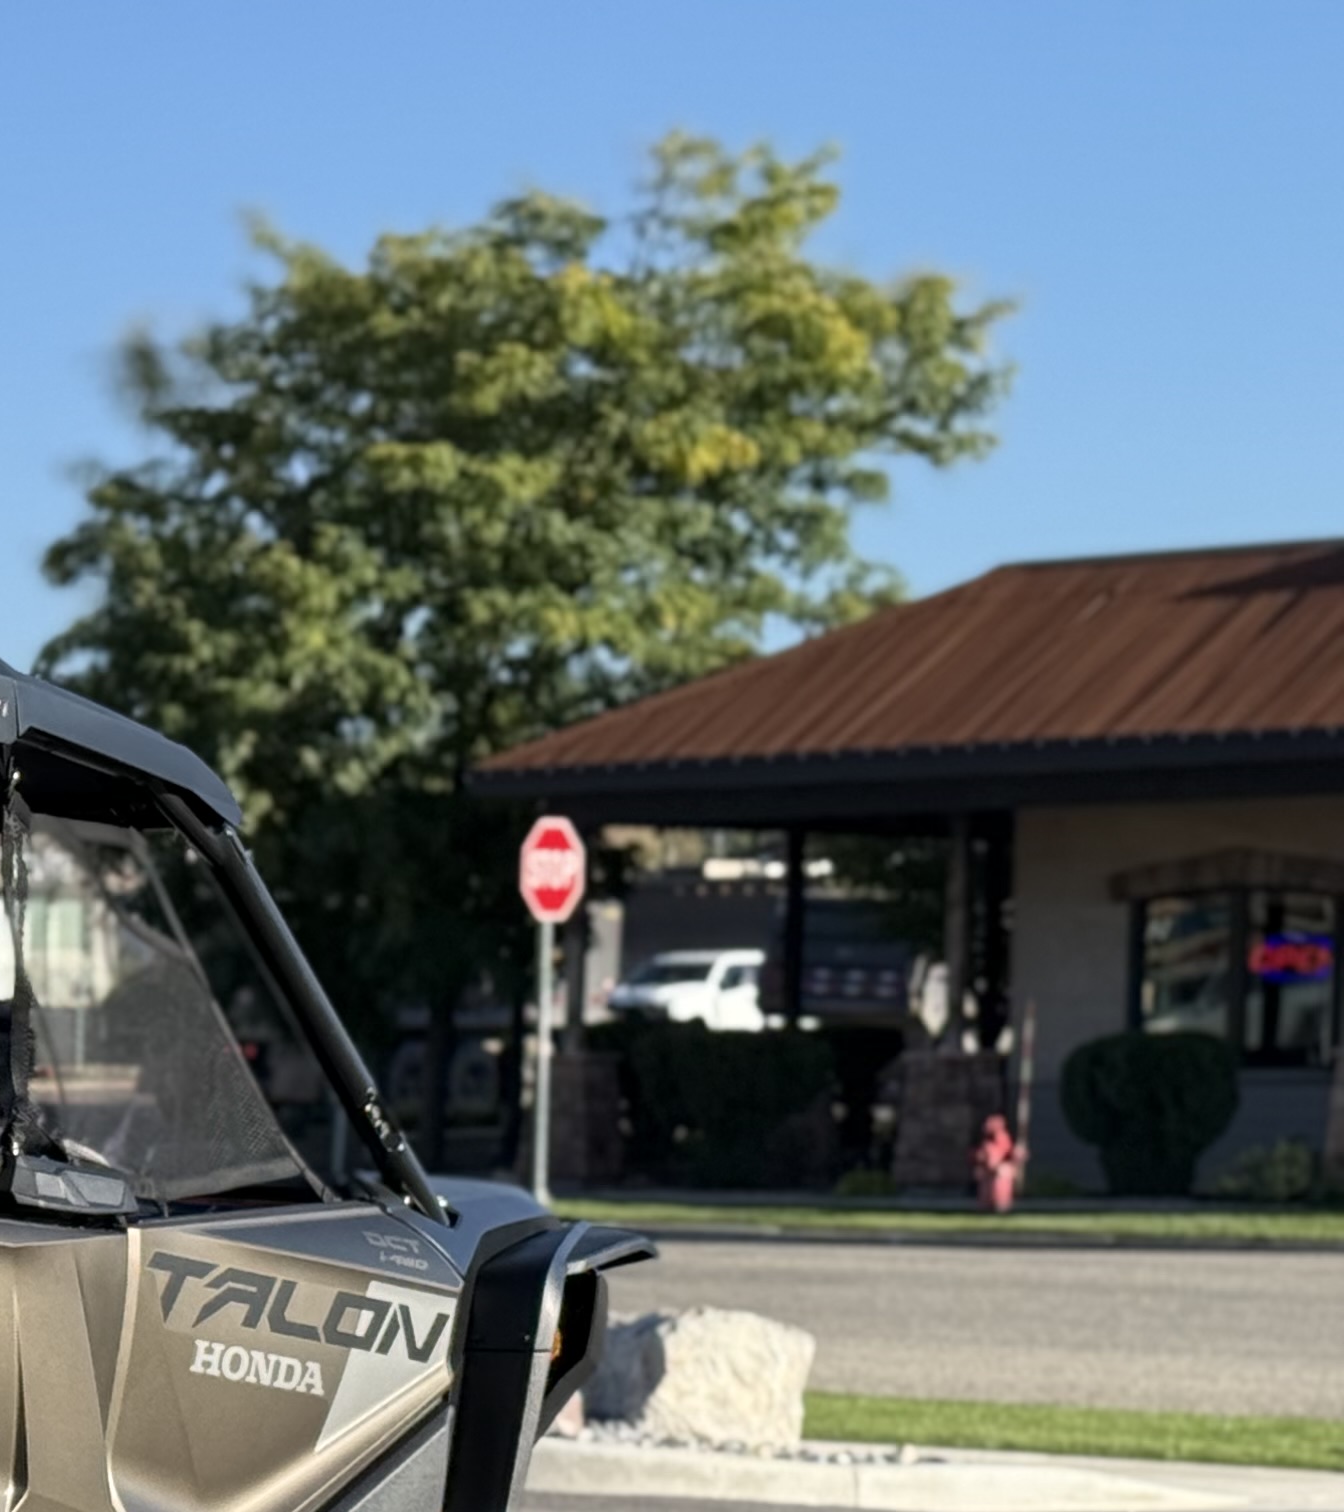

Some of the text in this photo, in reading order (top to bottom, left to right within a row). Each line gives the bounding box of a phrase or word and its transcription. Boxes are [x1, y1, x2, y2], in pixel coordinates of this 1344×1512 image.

[525, 847, 579, 888] STOP
[362, 1231, 419, 1254] DCT
[146, 1251, 450, 1363] TALON
[189, 1339, 325, 1397] HONDA
